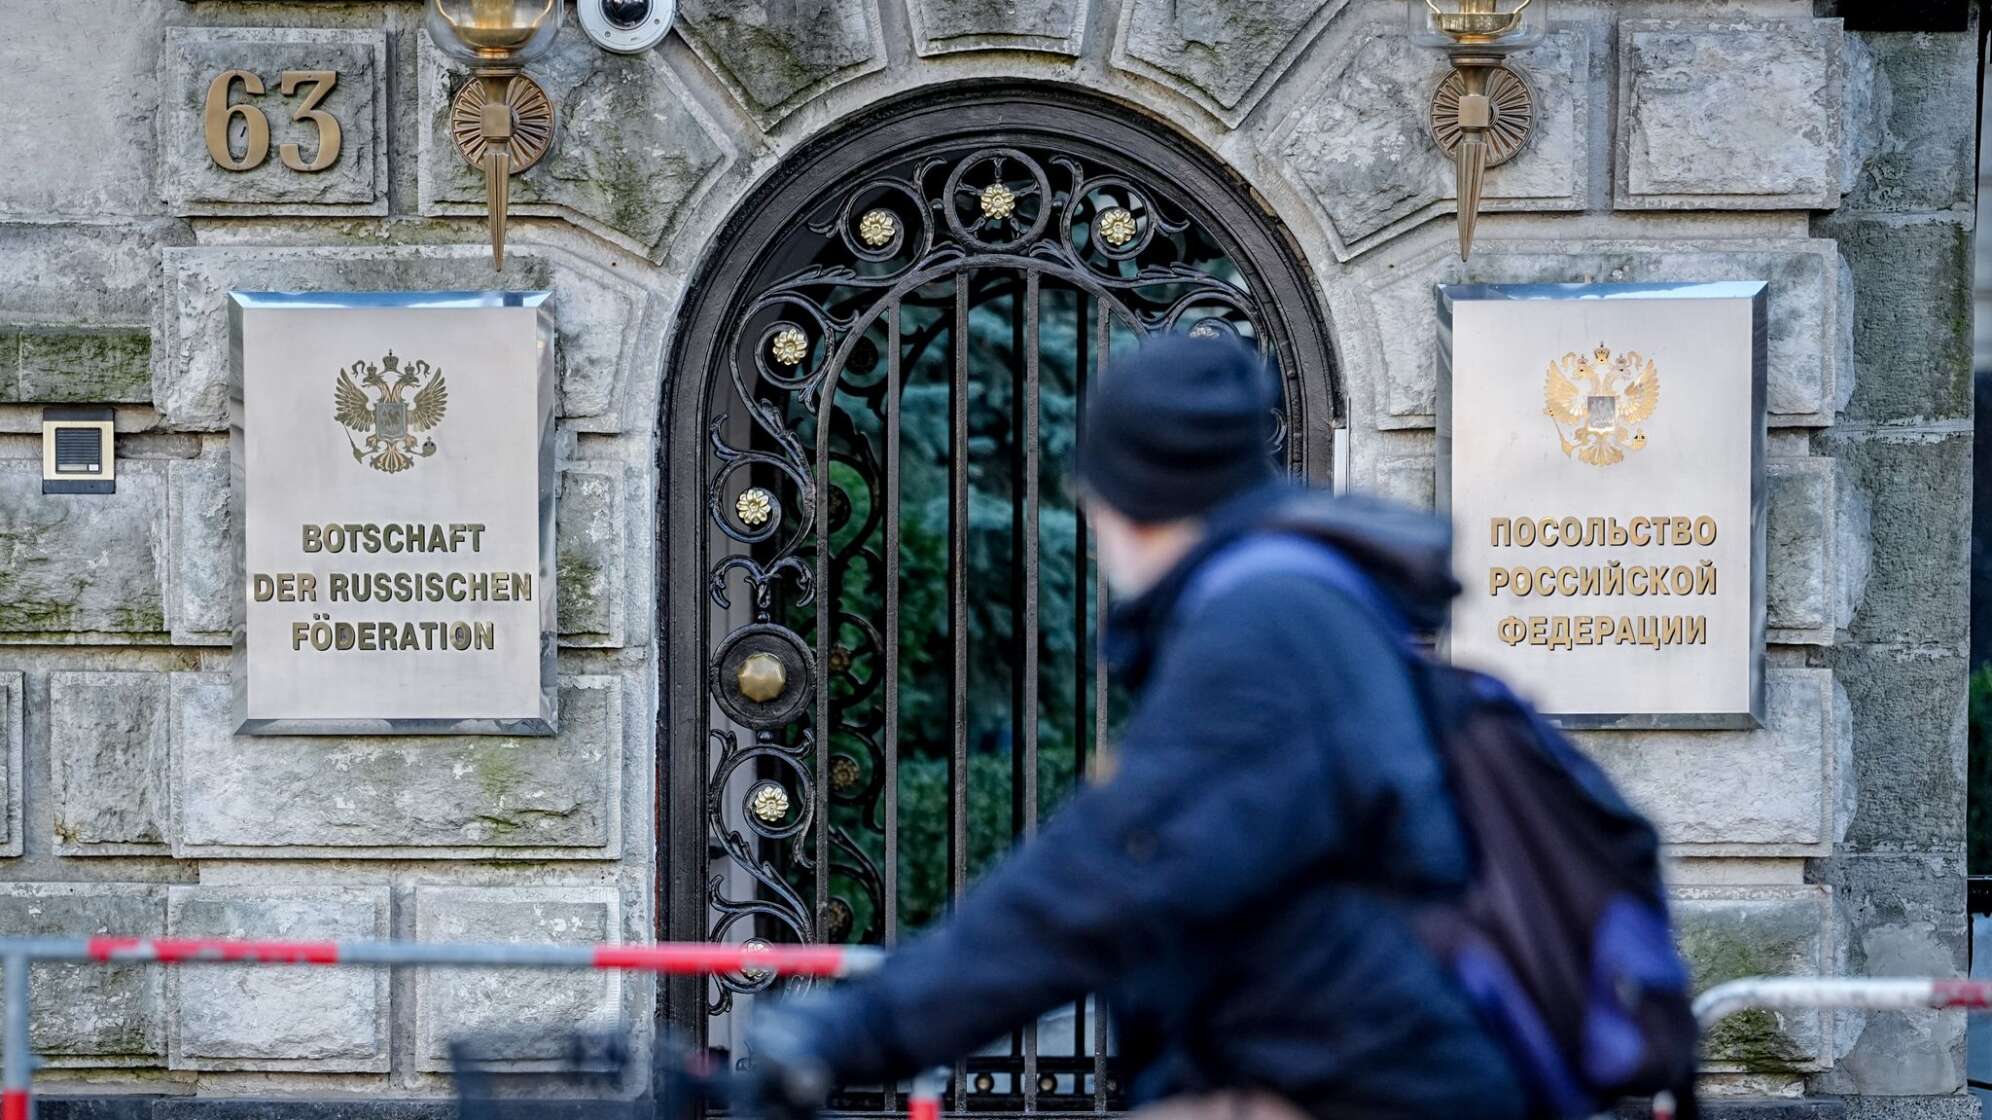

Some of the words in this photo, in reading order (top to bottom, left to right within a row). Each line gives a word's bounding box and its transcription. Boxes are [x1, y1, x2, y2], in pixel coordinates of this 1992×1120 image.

[205, 69, 342, 172] 63
[302, 523, 485, 553] BOTSCHAFT
[1490, 516, 1717, 547] ПОСОЛЬСТВО
[253, 573, 317, 601] DER
[329, 572, 532, 601] RUSSISCHEN
[1489, 560, 1717, 596] РОССИЙСКОЙ
[291, 613, 494, 651] FÖDERATION
[1497, 615, 1706, 651] ФЕДЕРАЦИИ
